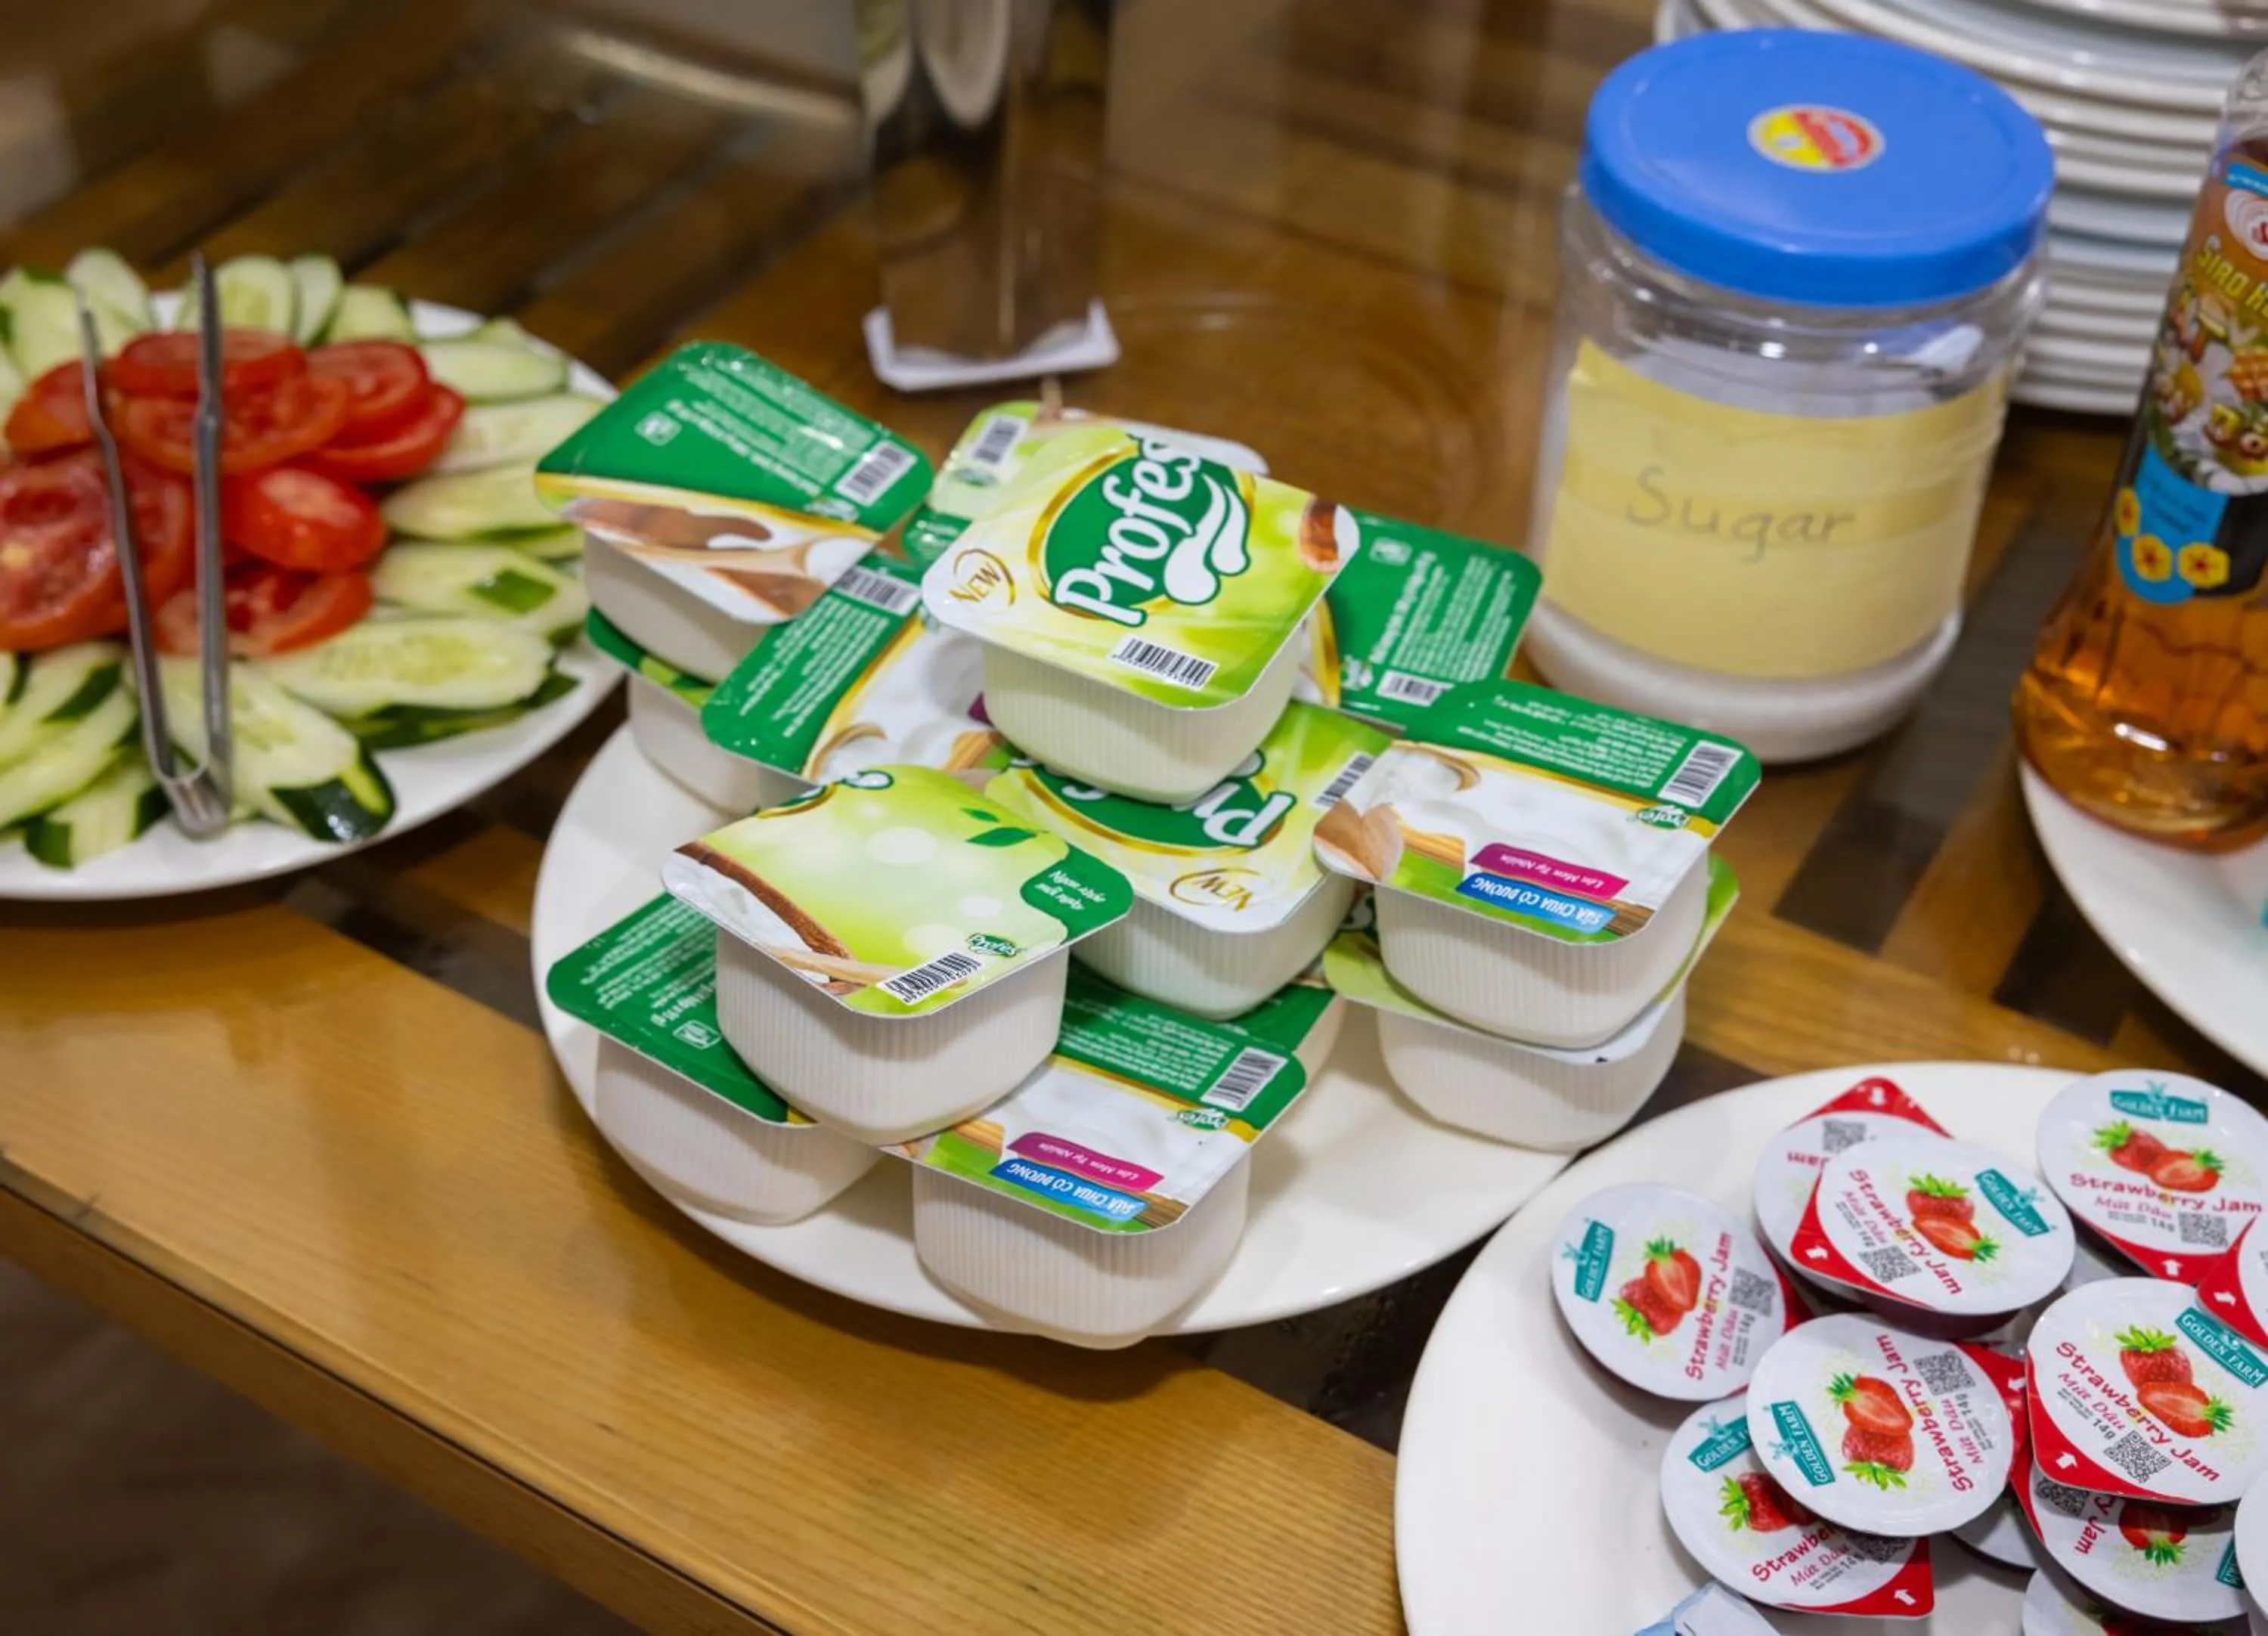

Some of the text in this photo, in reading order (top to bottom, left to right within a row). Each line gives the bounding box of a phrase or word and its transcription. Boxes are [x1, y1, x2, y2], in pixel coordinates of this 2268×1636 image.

[2197, 235, 2250, 298] SIRO
[1625, 465, 1857, 564] Sugar
[948, 562, 1001, 603] NEW
[1191, 875, 1253, 911] NEW
[1539, 897, 1576, 917] CHUA
[2069, 1173, 2263, 1213] Strawberry Jam
[1849, 1169, 1963, 1296] Strawberry Jam
[1685, 1232, 1732, 1380] Strawberry Jam
[2181, 1313, 2265, 1384] GOLDEN FARM
[1876, 1334, 1974, 1492] Strawberry Jam
[1954, 1393, 1972, 1417] 14g
[2056, 1341, 2172, 1445] Strawberry
[2170, 1447, 2220, 1482] Jam
[2092, 1418, 2116, 1440] 14g
[1696, 1436, 1740, 1468] GOLDEN
[1777, 1404, 1828, 1483] GOLDEN FARM
[1752, 1527, 1831, 1582] Strawbe
[2074, 1516, 2107, 1555] Jam
